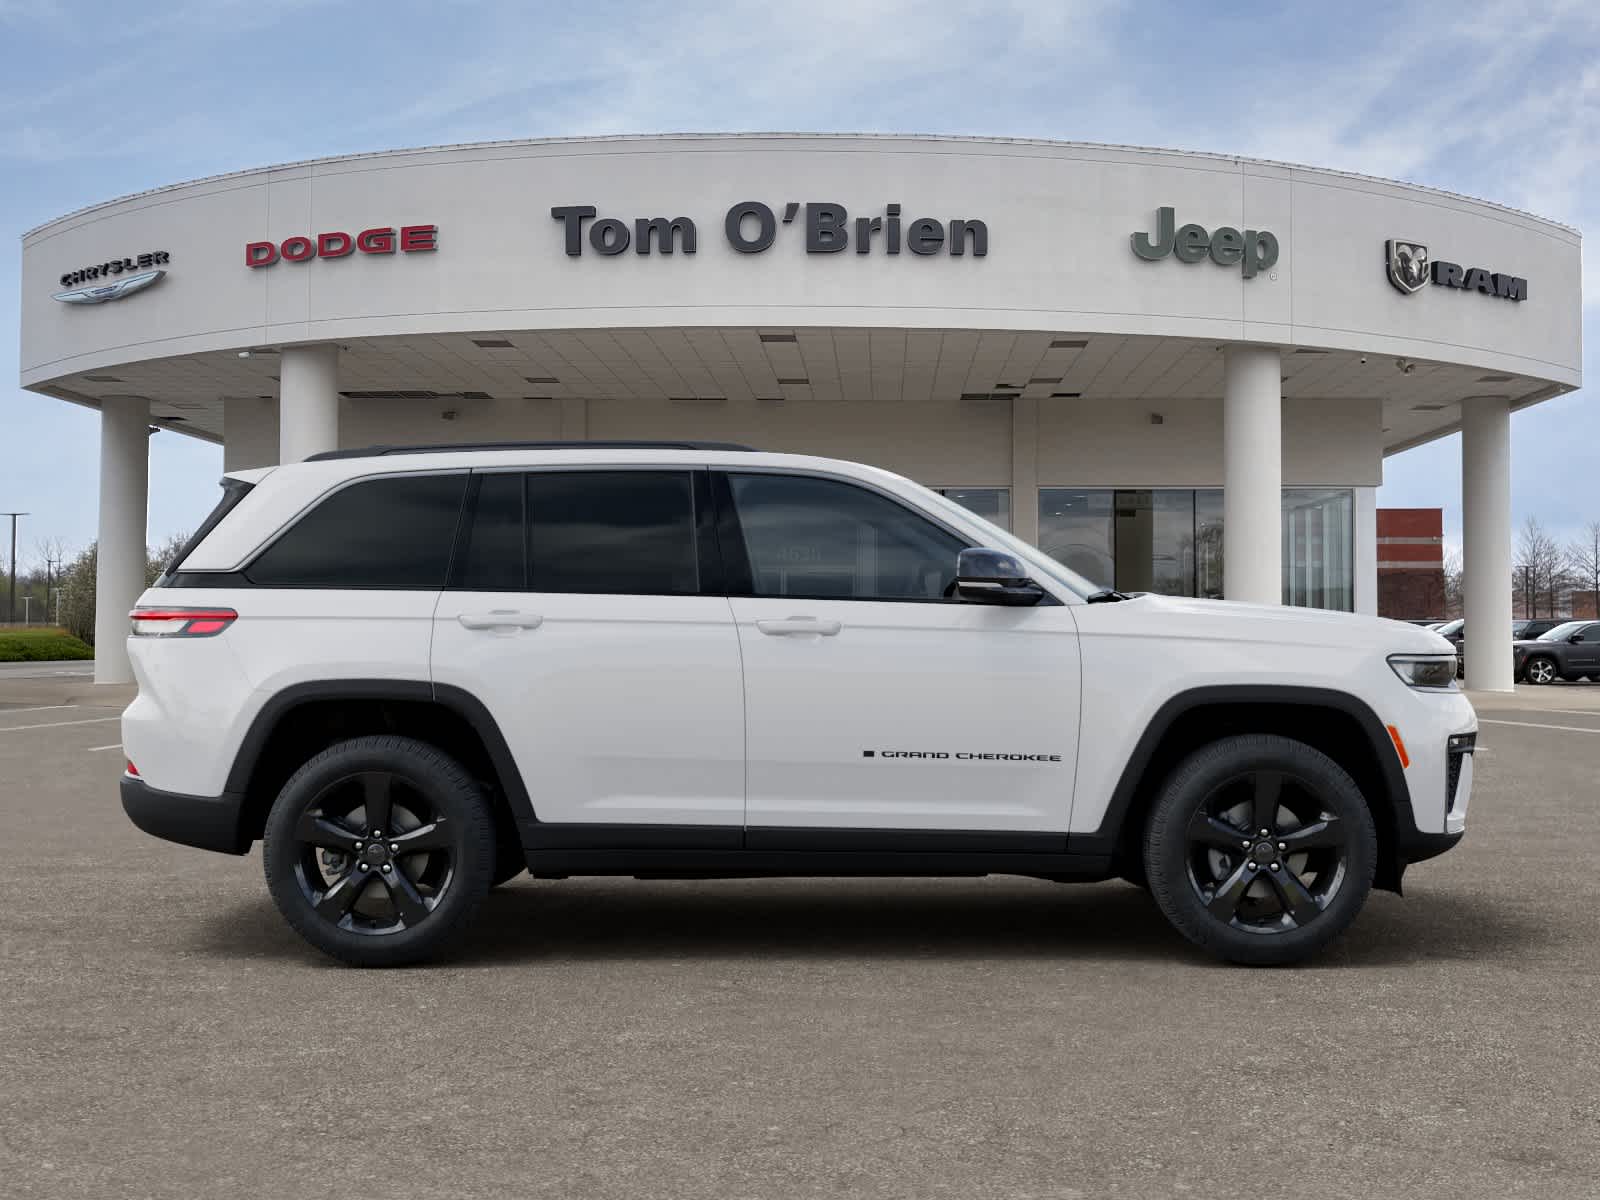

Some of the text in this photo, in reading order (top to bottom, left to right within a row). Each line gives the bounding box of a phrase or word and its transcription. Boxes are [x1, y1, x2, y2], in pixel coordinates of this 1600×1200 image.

[245, 224, 437, 269] DODGE
[551, 201, 989, 256] Tom O'Brien
[1130, 207, 1279, 279] Jeep
[60, 250, 170, 287] CHRYSLER
[1430, 260, 1528, 302] RAM
[881, 750, 1063, 763] GRAND CHEROKEE
